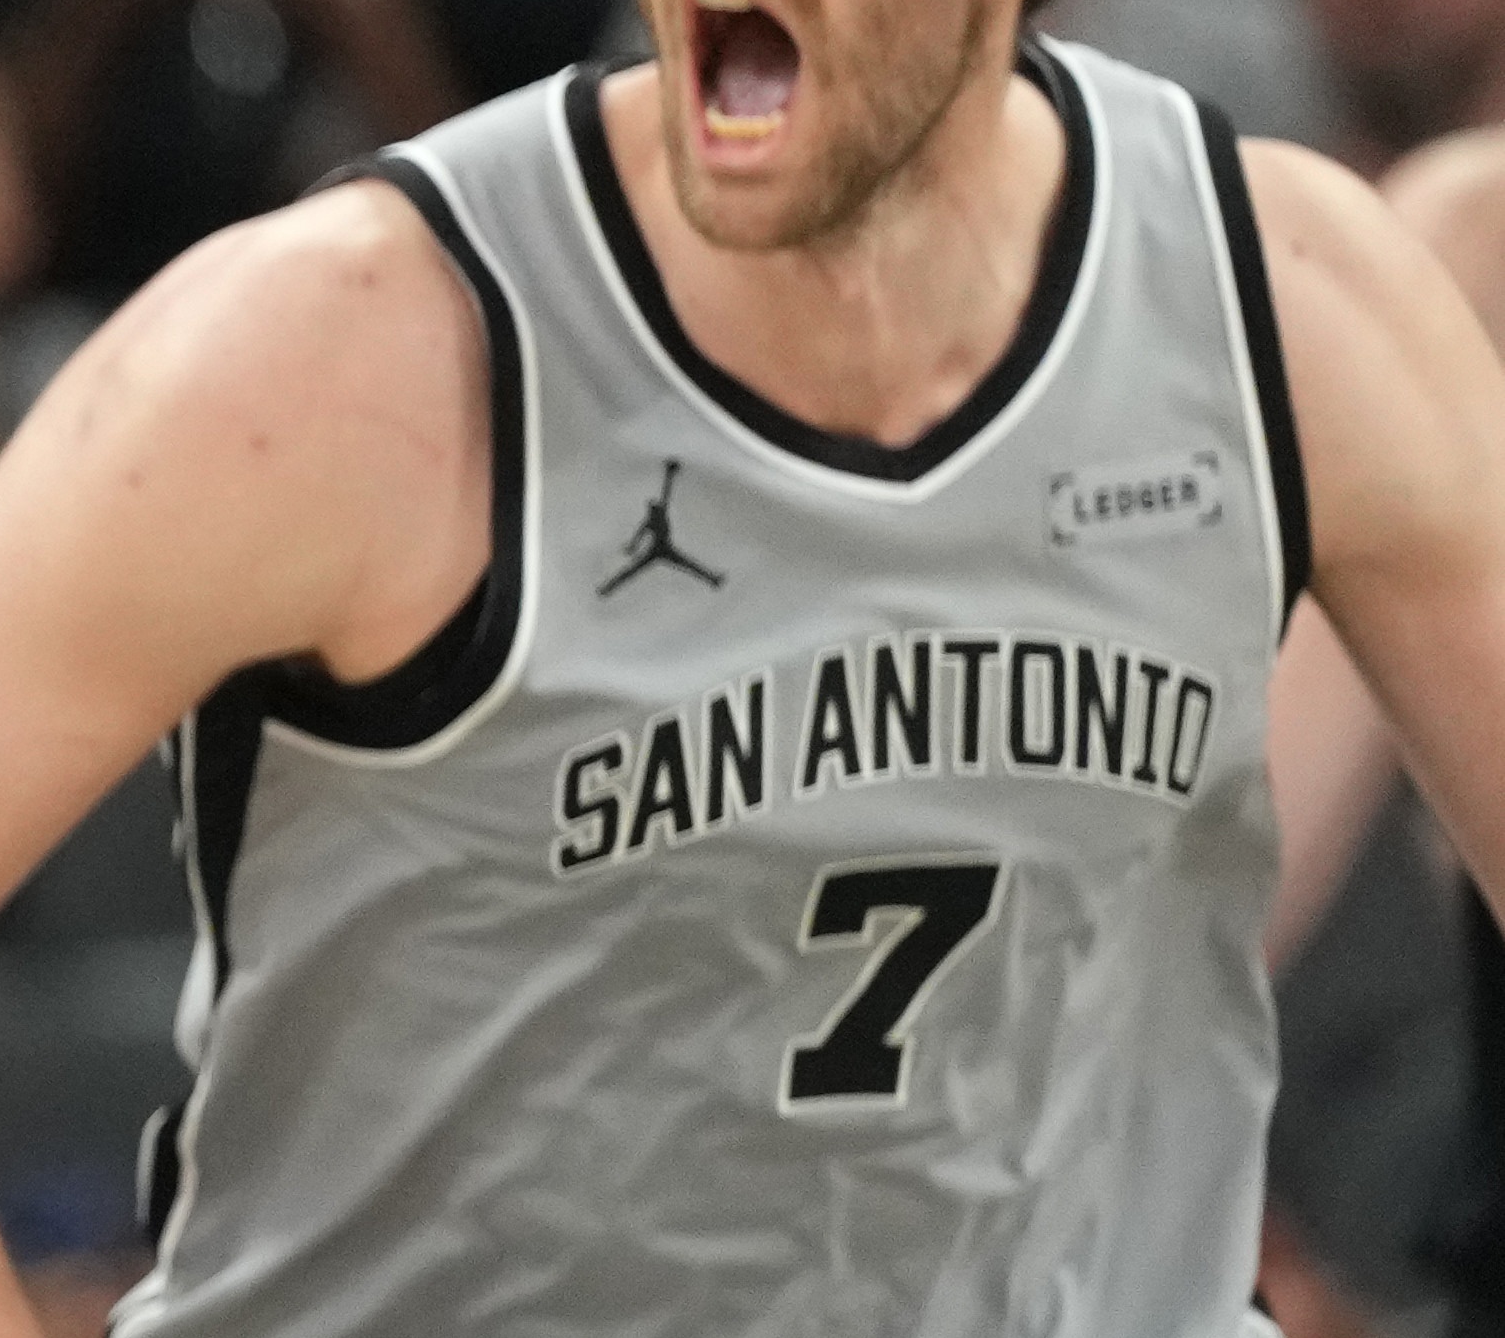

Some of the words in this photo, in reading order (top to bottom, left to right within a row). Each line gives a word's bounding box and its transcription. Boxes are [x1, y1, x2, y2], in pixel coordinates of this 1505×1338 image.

[1072, 473, 1200, 526] LEDGER
[552, 668, 773, 878] SAN
[795, 630, 1218, 806] ANTONIO
[778, 853, 1012, 1118] 7
